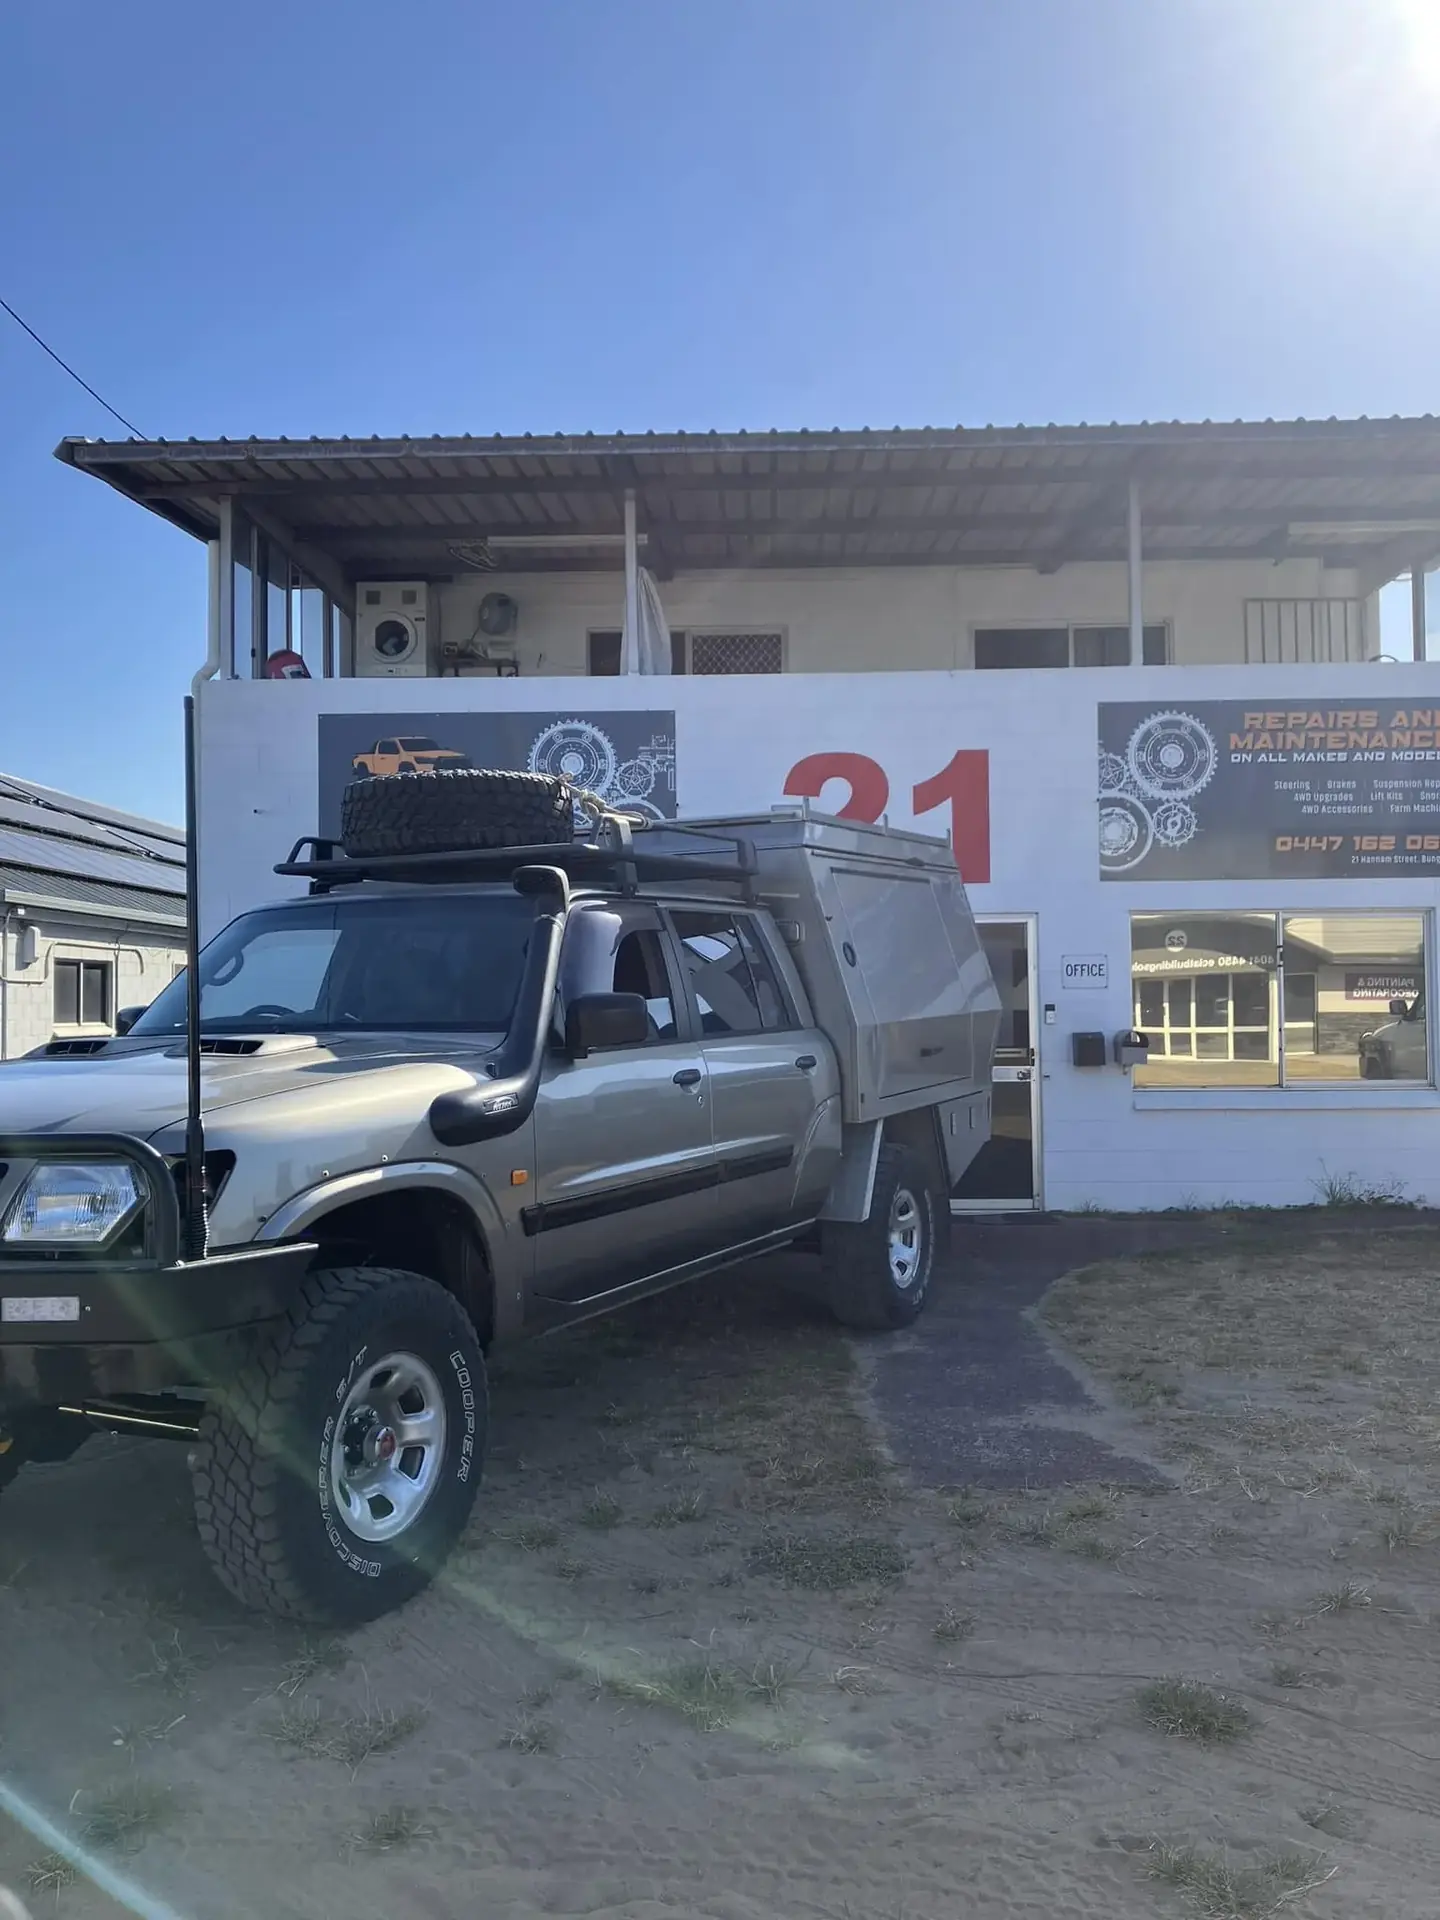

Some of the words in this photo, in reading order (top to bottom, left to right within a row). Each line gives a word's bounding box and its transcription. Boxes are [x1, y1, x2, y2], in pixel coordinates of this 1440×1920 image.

[1244, 711, 1378, 729] REPAIRS
[1389, 710, 1440, 728] AN
[1229, 730, 1440, 750] MAINTENANC
[1231, 753, 1252, 763] ON
[1257, 752, 1287, 762] ALL
[1293, 752, 1347, 762] MAKES
[1352, 751, 1385, 761] AND
[1274, 780, 1310, 791] Steering
[1327, 780, 1356, 789] Brakes
[1373, 779, 1422, 789] Suspension
[1294, 793, 1311, 802] 4WD
[1314, 792, 1353, 803] Upgrades
[1371, 791, 1385, 801] Lift
[1386, 791, 1403, 801] Kits
[783, 748, 990, 884] 21
[1302, 804, 1319, 814] 4WD
[1321, 804, 1373, 814] Accessories
[1390, 804, 1411, 813] Farm
[1276, 836, 1343, 851] 0447
[1353, 836, 1396, 850] 162
[1065, 963, 1105, 977] OFFICE
[450, 1350, 475, 1482] COOPER
[317, 1416, 381, 1577] DISCOVERER
